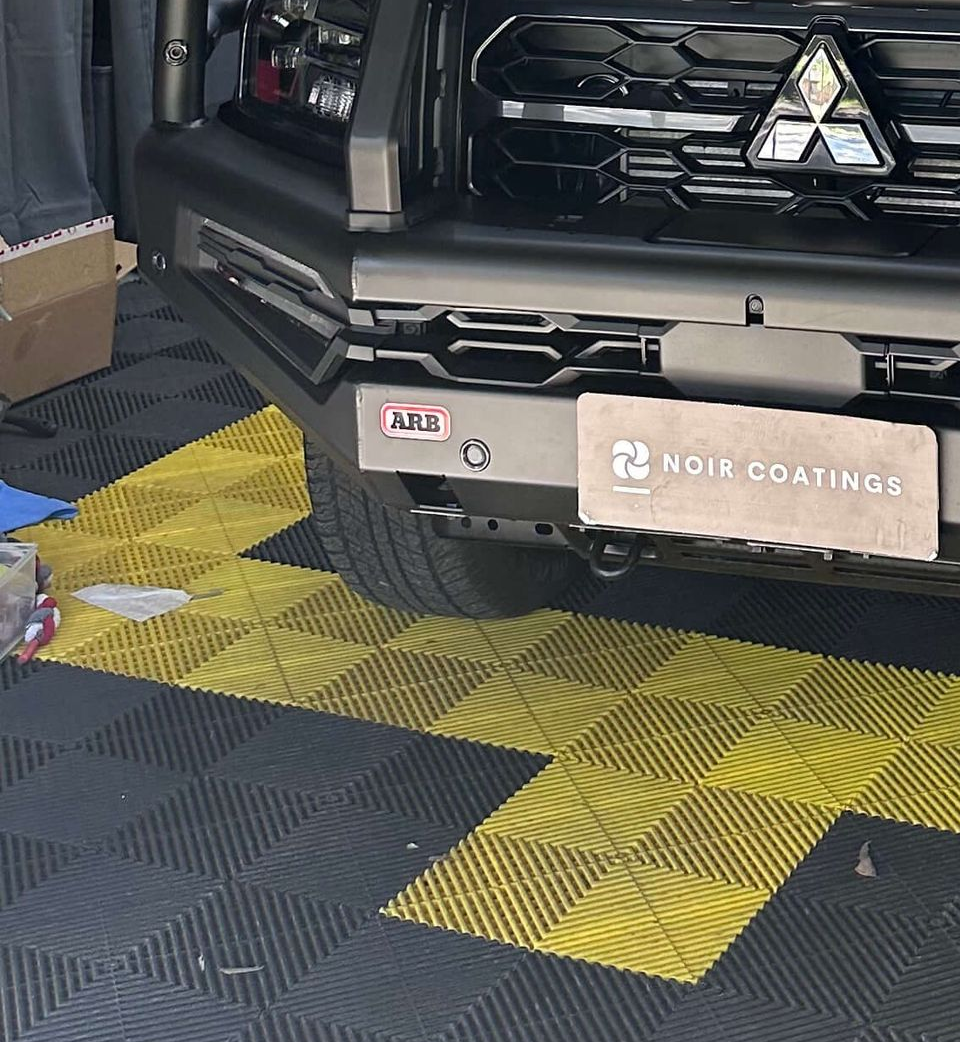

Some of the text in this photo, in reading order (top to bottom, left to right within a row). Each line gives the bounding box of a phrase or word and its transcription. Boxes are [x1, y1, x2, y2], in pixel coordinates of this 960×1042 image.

[391, 411, 441, 433] ARB
[663, 453, 903, 497] NOIR COATINGS
